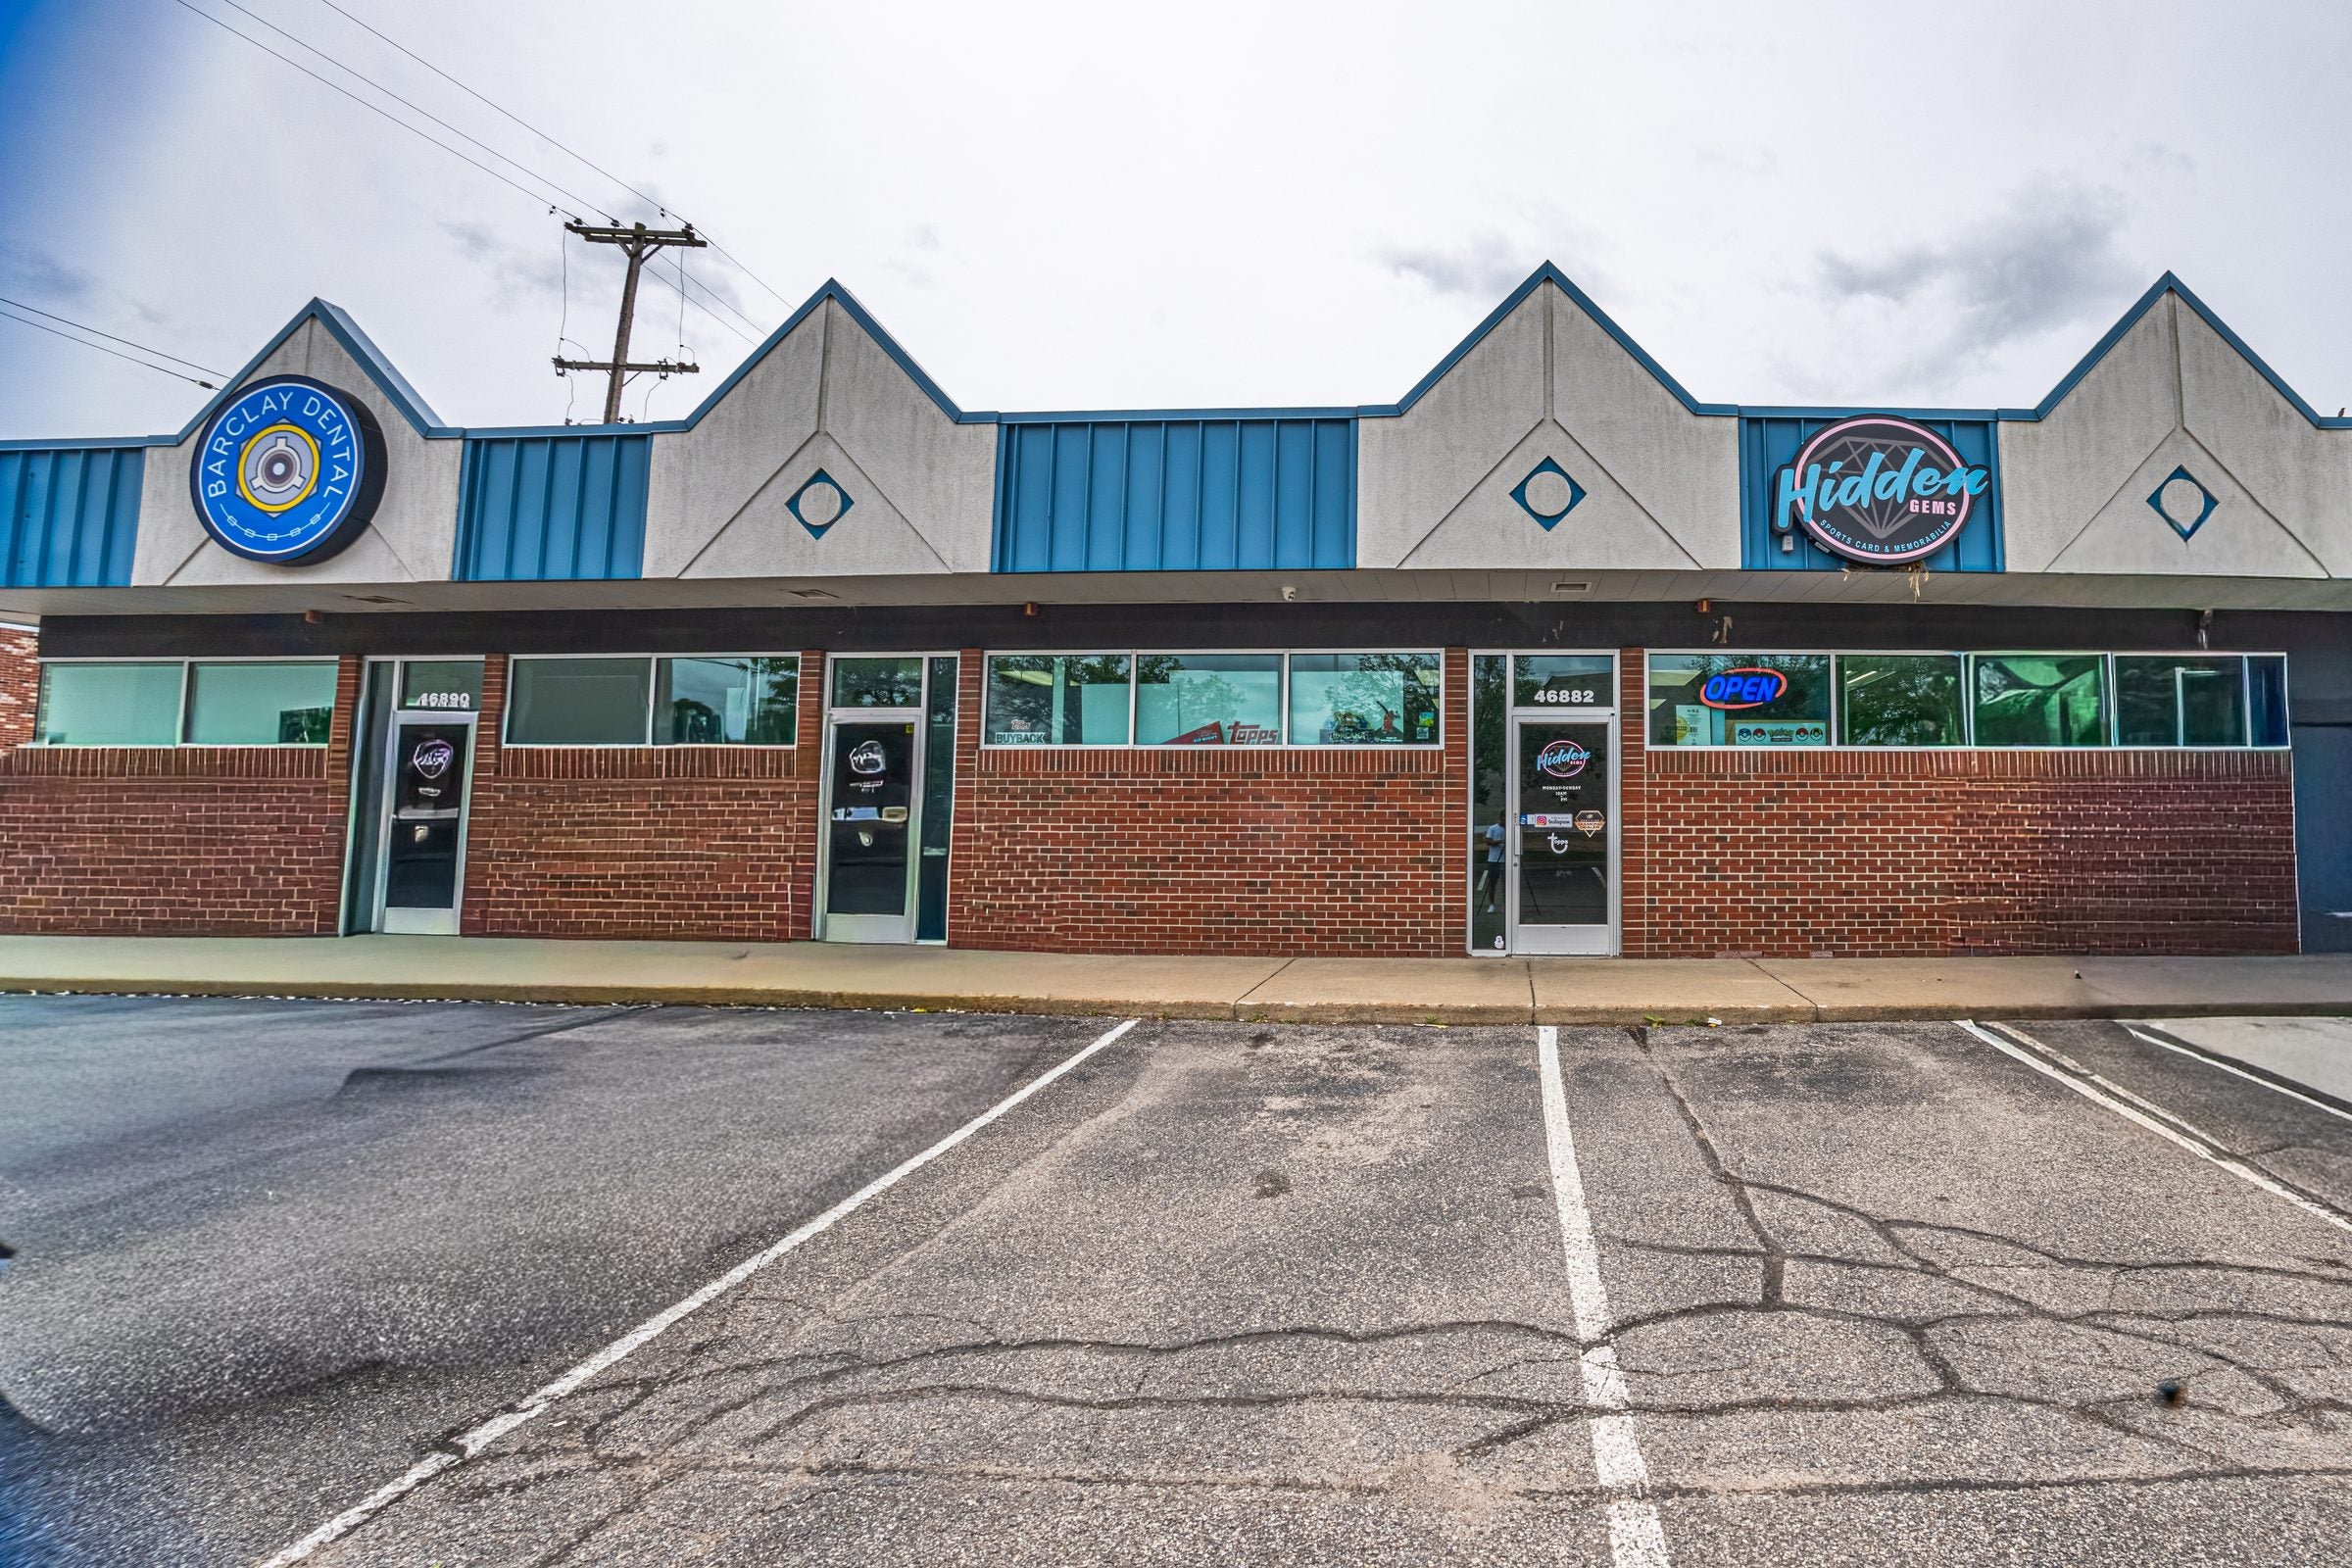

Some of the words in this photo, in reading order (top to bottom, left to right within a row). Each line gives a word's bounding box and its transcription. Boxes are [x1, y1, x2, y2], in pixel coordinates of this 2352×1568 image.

[208, 392, 294, 498] BARCLAY
[302, 396, 351, 499] DENTAL
[1777, 448, 1989, 528] Hidden
[1909, 499, 1957, 515] GEMS
[1820, 519, 1852, 545] SPORTS
[1855, 540, 1880, 552] CARD
[1893, 520, 1952, 553] MEMORABILIA
[1534, 690, 1594, 704] 46882
[1703, 675, 1779, 703] OPEN
[996, 733, 1045, 744] BUYBACK
[1537, 747, 1591, 771] Hidden
